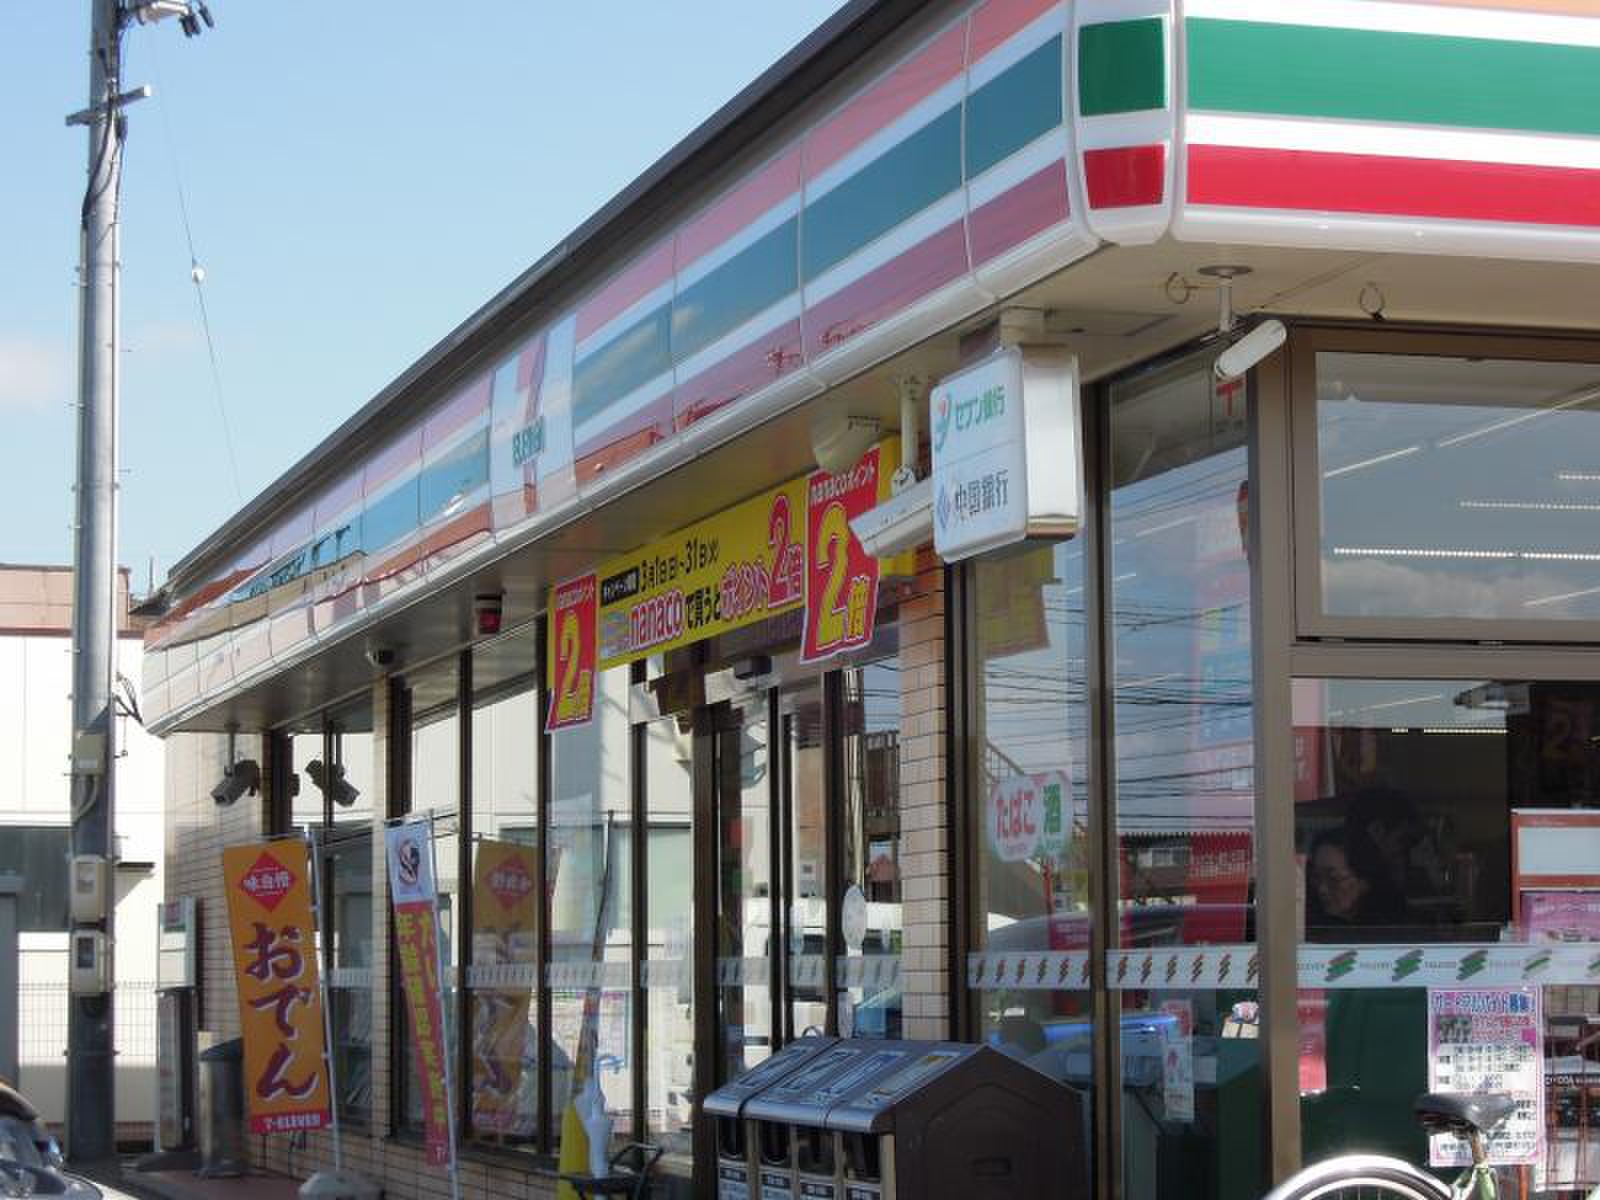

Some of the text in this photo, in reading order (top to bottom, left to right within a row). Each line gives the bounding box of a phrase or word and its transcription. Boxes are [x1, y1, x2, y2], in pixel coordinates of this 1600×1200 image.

[955, 384, 1006, 432] セブン銀行
[954, 469, 1010, 516] 中国銀行
[243, 921, 321, 1101] おでん
